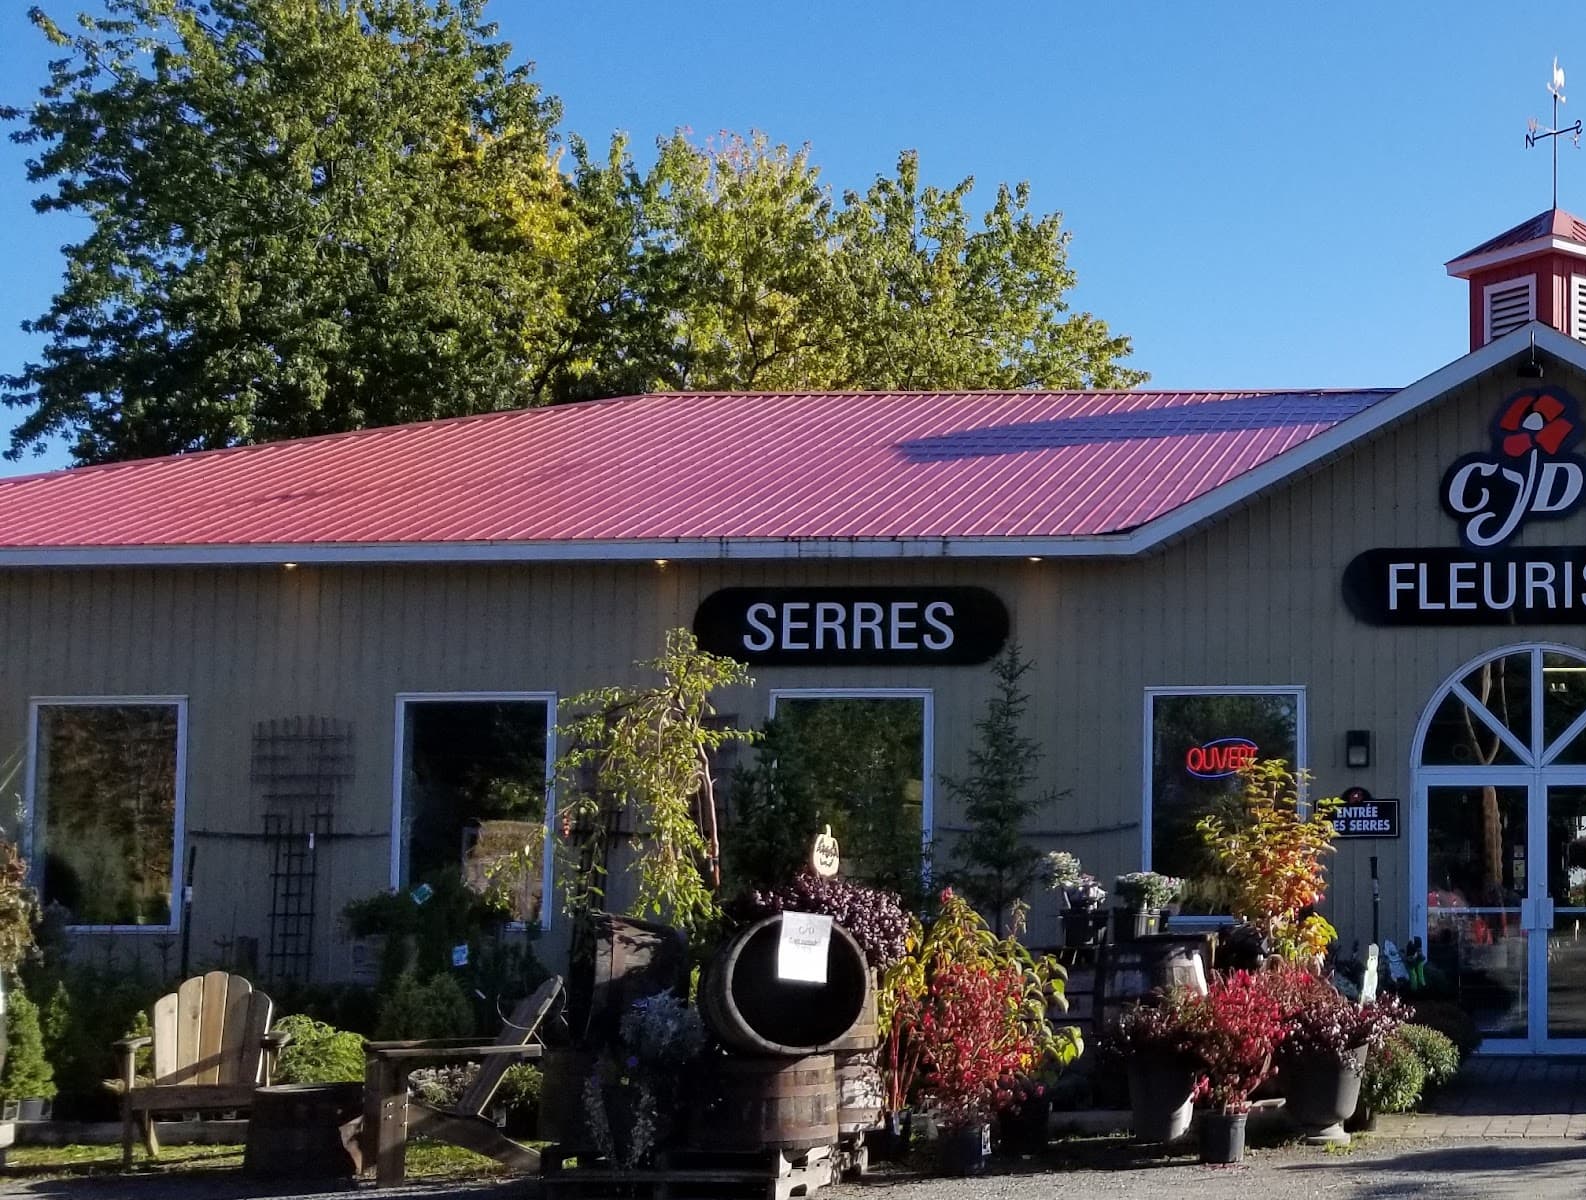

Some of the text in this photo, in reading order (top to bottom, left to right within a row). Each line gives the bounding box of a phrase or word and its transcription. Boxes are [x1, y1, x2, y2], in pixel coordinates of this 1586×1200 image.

[743, 601, 955, 651] SERRES
[1337, 803, 1378, 818] ENTRÉE
[1349, 820, 1390, 831] SERRES
